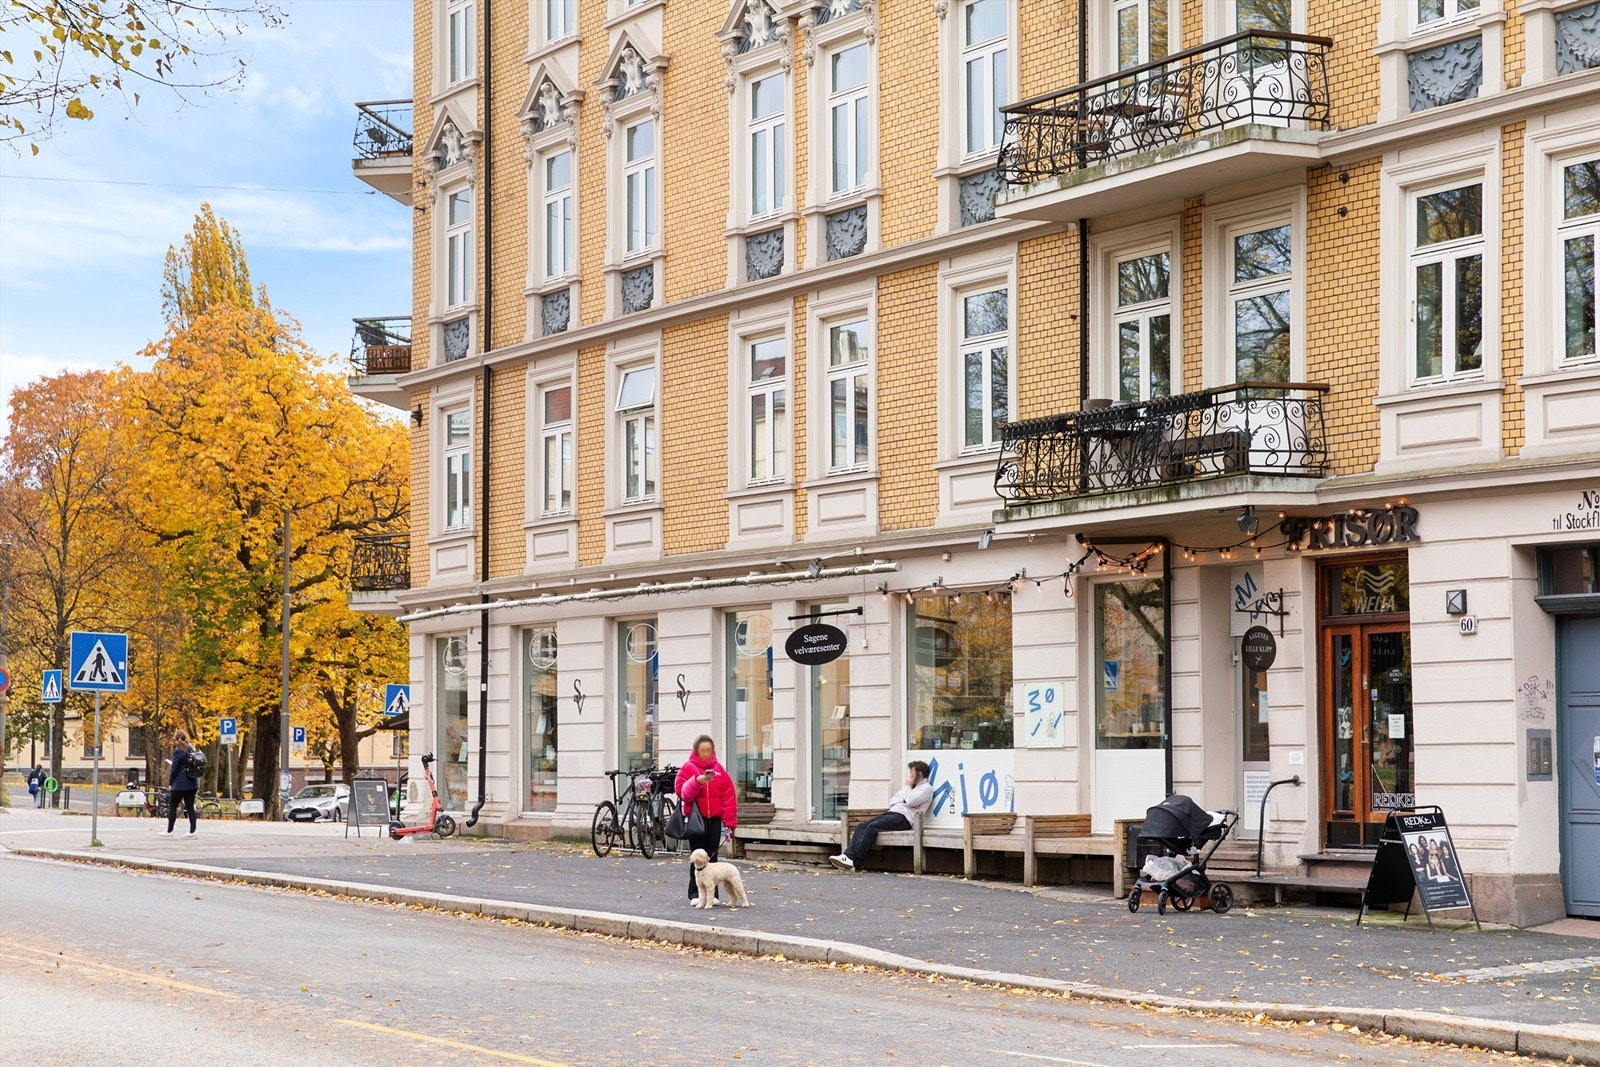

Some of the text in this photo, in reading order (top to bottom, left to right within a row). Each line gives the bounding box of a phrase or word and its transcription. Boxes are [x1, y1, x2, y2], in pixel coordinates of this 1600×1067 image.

[1280, 506, 1421, 551] FRISØR
[1354, 595, 1395, 613] WELLA
[1460, 618, 1473, 632] 60
[803, 633, 829, 644] Sagene
[793, 643, 841, 655] velværesenter
[223, 720, 232, 733] P
[295, 728, 303, 740] P
